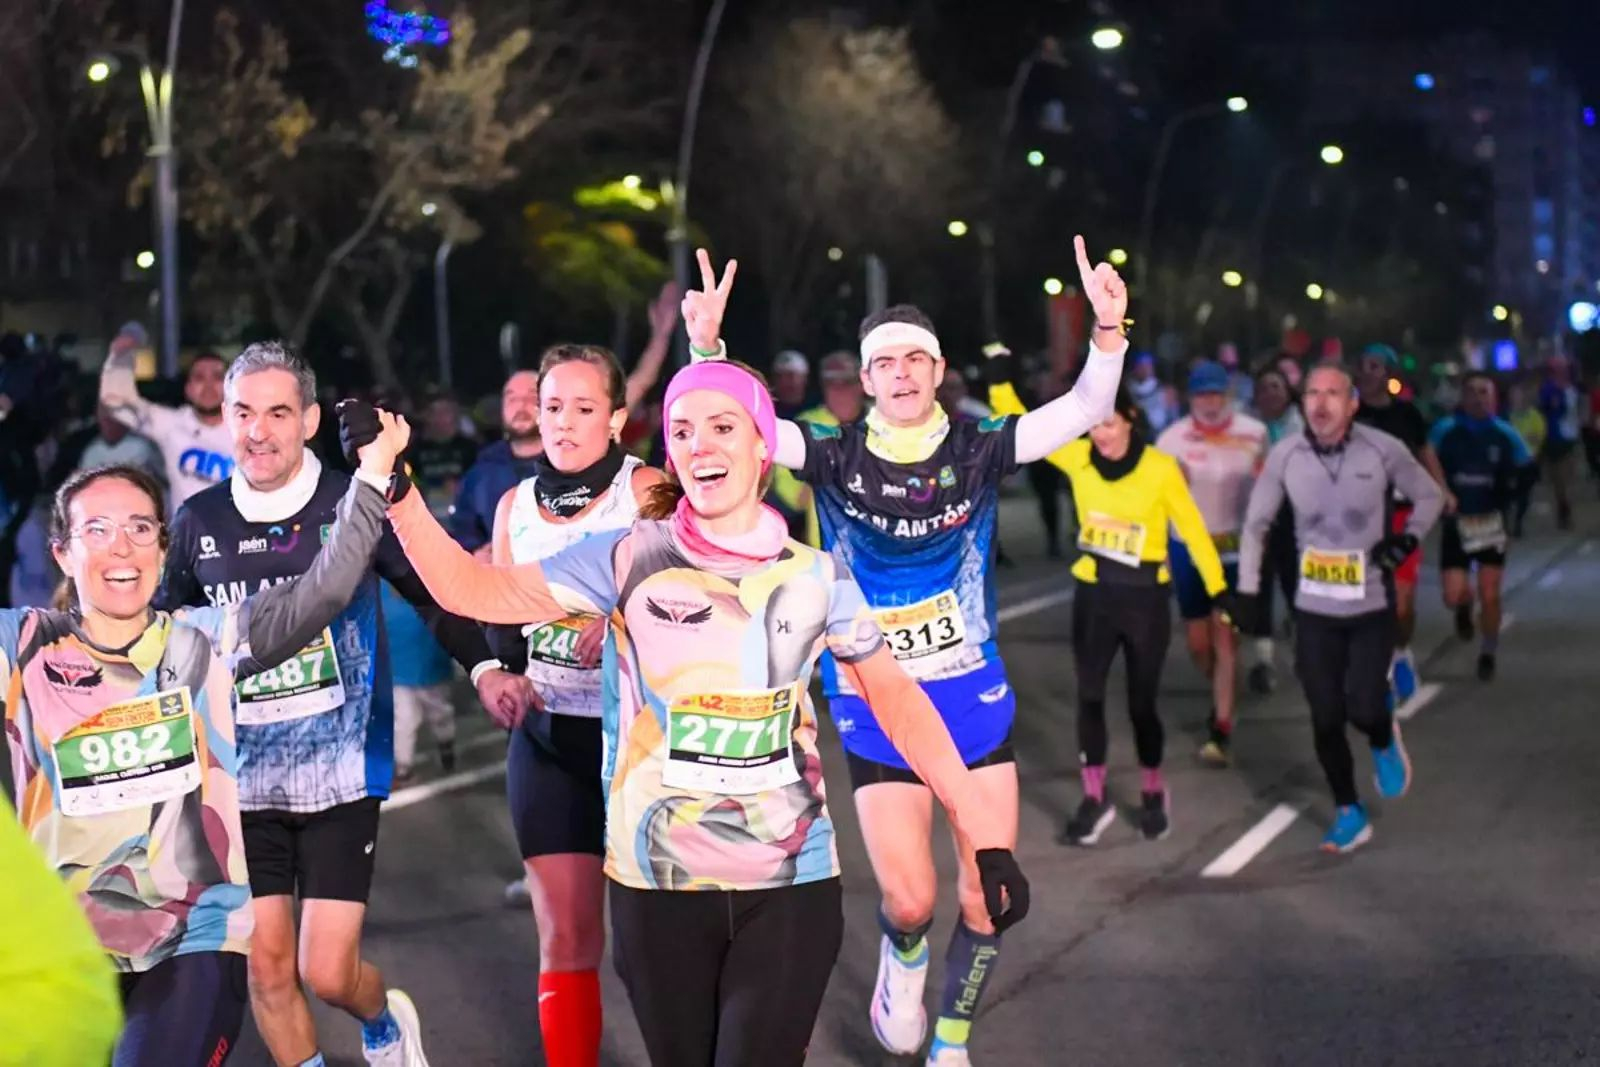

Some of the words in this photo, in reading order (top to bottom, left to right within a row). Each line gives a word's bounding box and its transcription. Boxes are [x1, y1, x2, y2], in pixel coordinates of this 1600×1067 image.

[203, 580, 247, 608] SAN
[80, 723, 174, 773] 982
[678, 713, 781, 757] 2771
